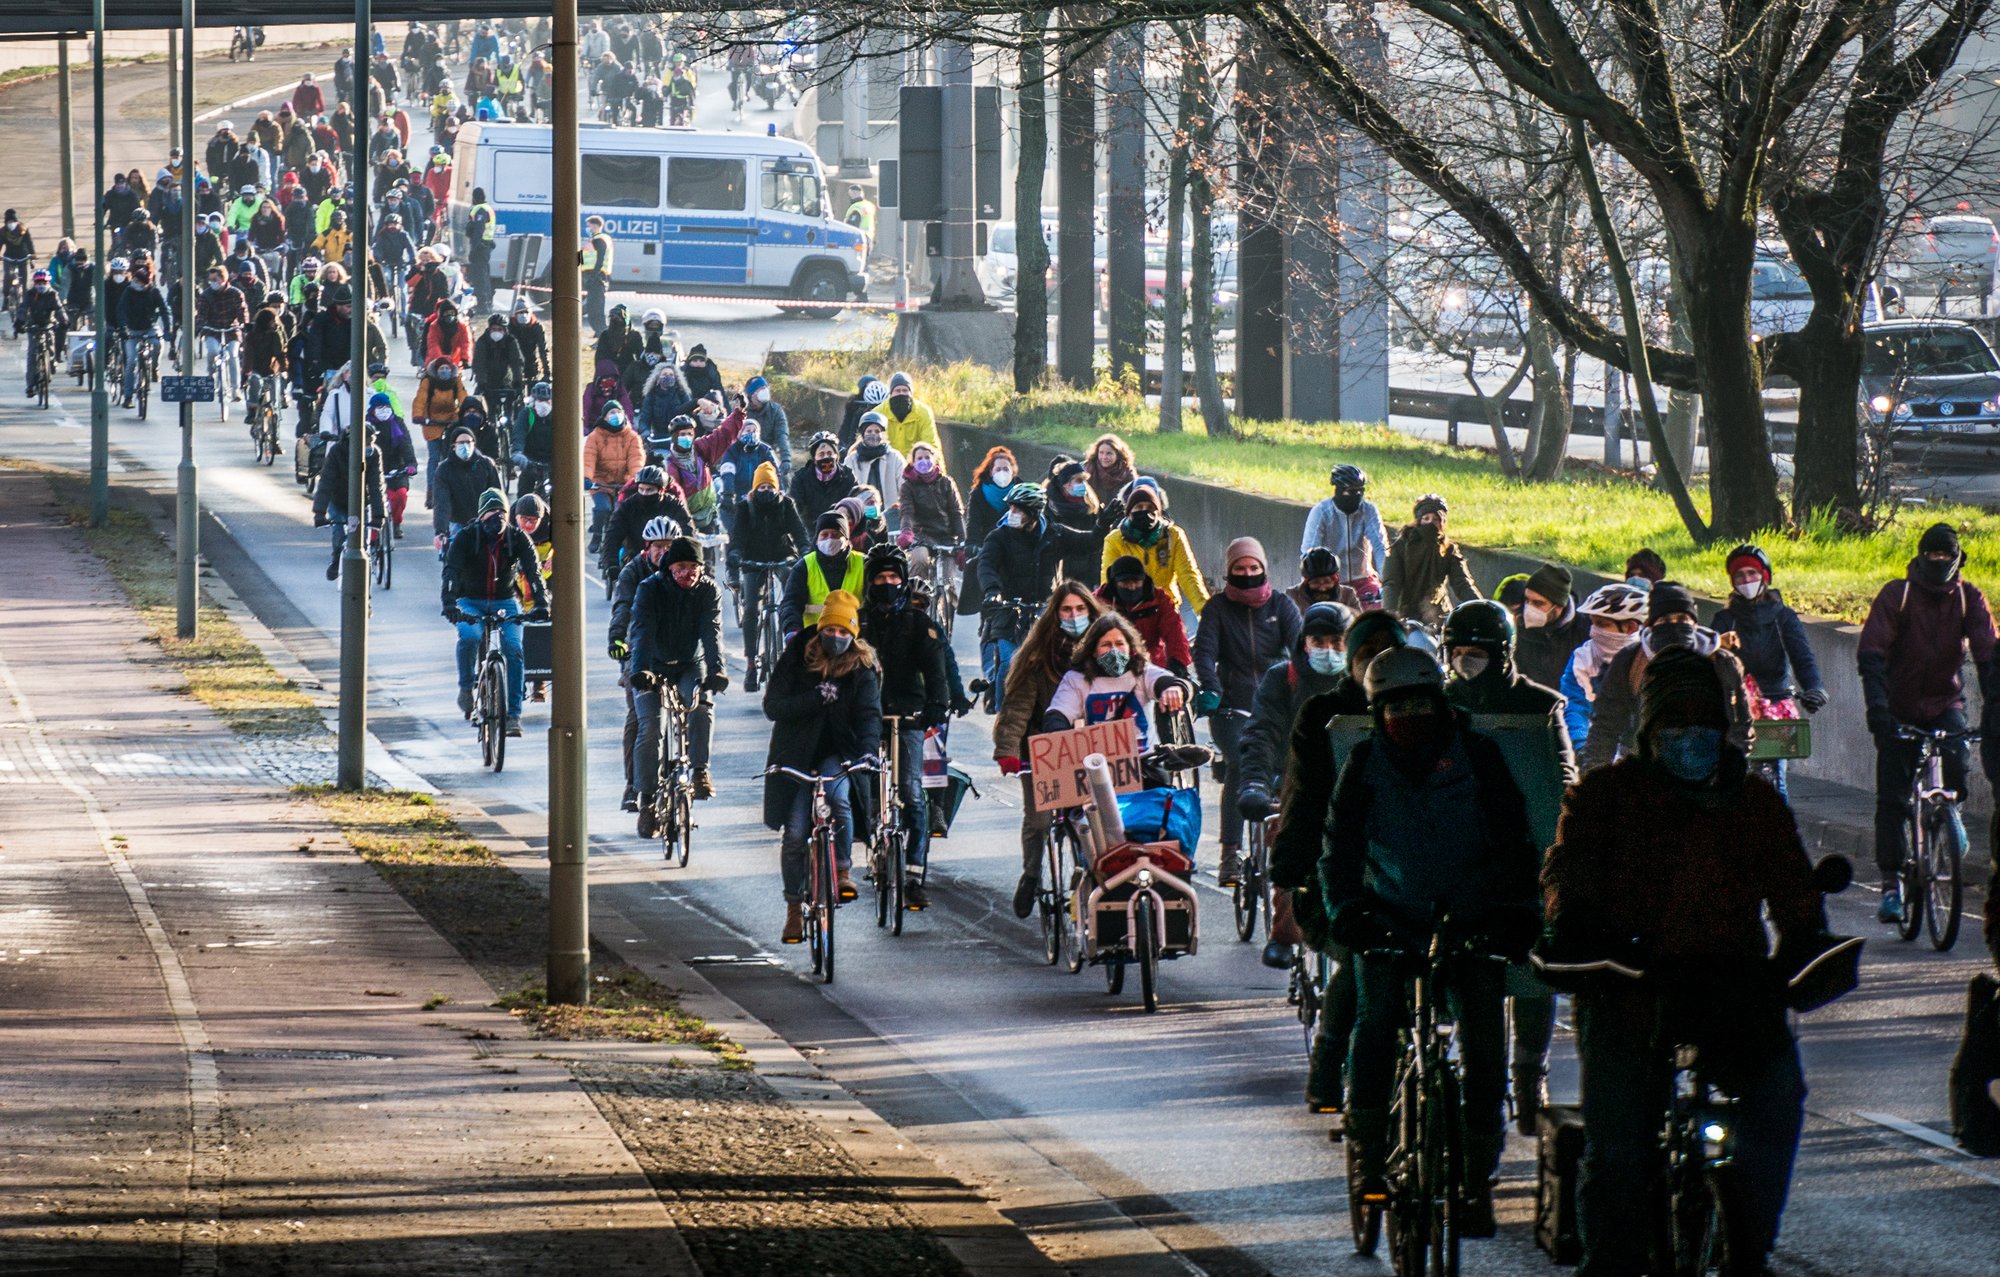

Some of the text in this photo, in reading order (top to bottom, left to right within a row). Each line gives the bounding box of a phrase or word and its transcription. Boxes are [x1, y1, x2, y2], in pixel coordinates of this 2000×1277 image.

[604, 219, 658, 235] OLIZEI
[1031, 721, 1131, 775] RADELN
[1074, 756, 1141, 797] RDEN
